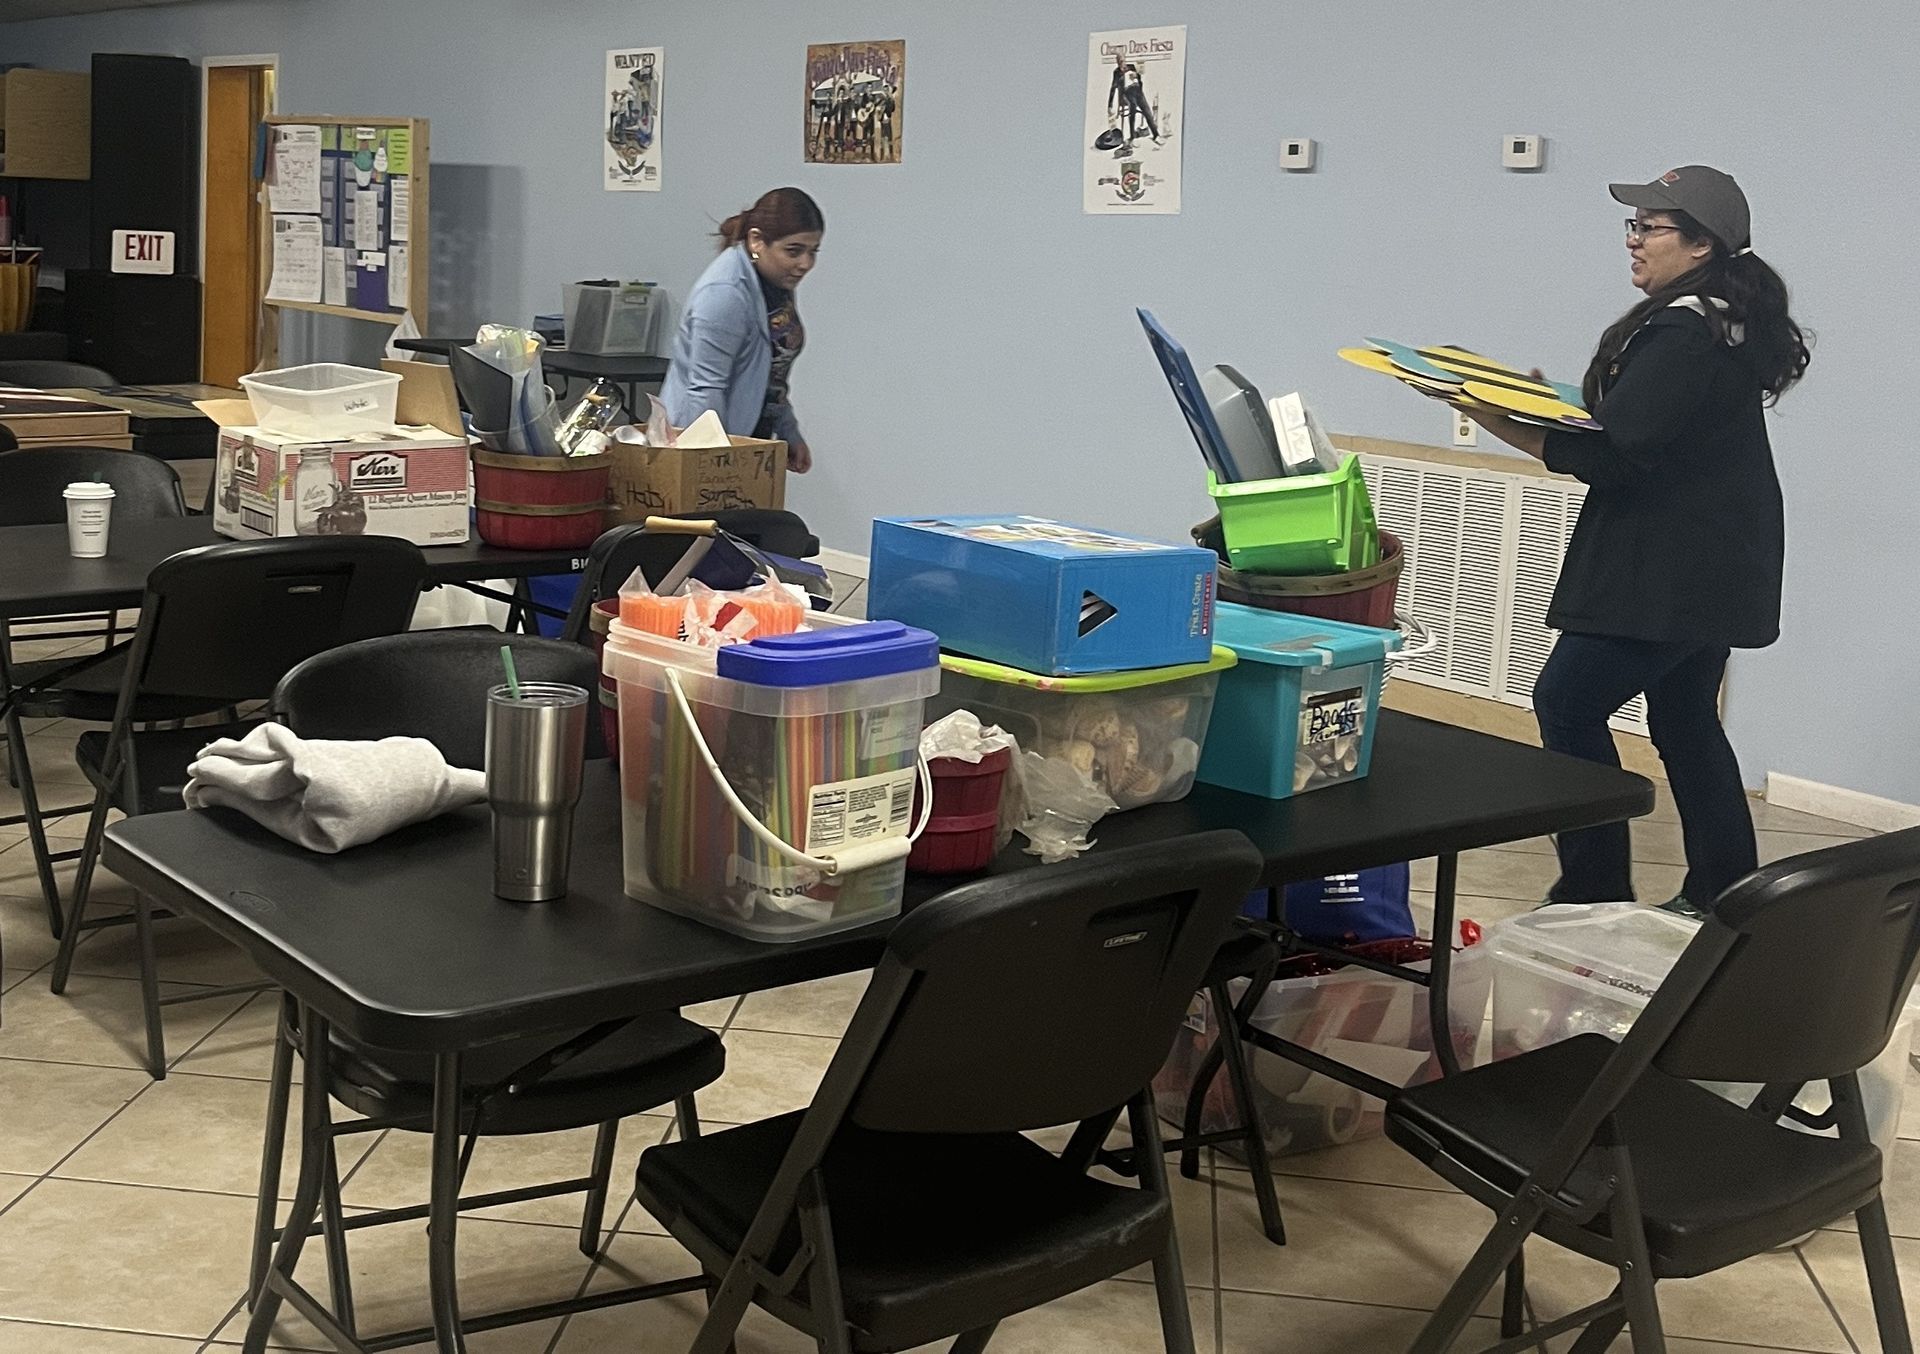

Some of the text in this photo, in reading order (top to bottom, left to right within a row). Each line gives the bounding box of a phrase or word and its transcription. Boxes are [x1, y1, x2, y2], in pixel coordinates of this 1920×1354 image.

[1101, 38, 1173, 56] Charro Days Fiesta
[615, 53, 656, 69] WANTED
[125, 234, 164, 261] EXIT
[357, 456, 399, 476] Kerr
